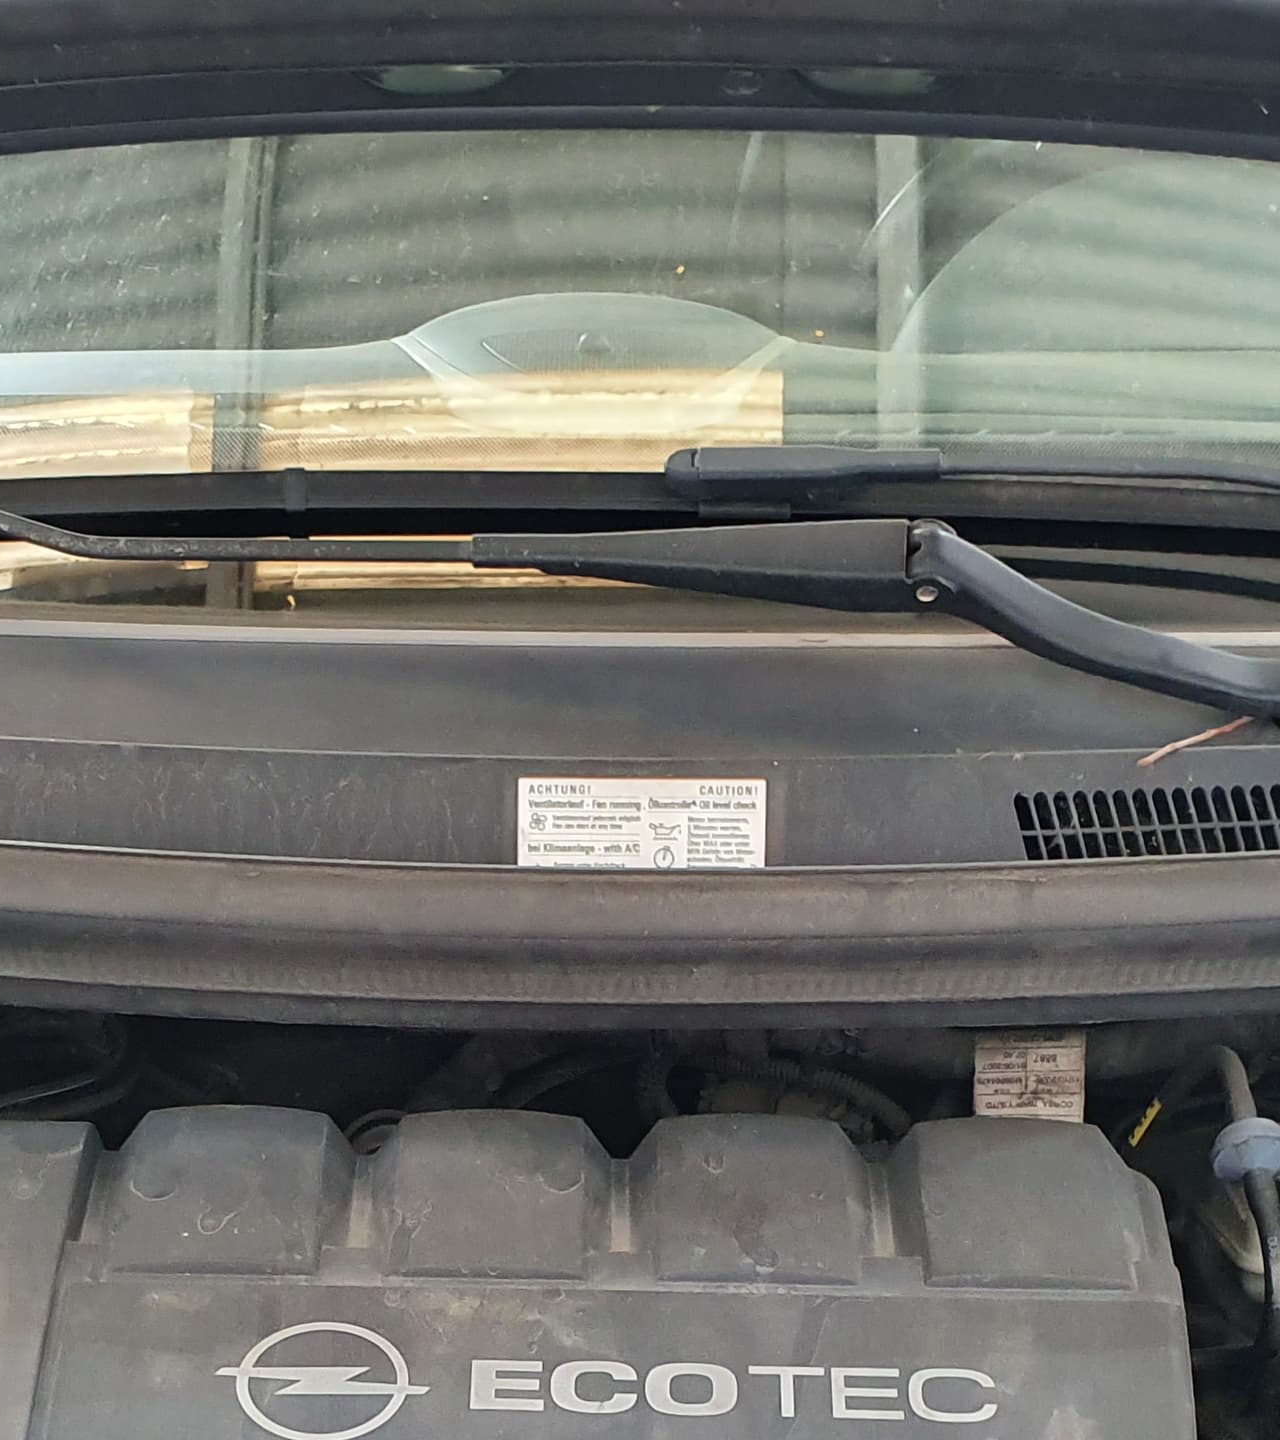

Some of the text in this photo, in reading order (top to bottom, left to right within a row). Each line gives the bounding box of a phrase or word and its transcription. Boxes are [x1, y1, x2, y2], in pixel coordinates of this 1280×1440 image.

[528, 784, 591, 795] ACHTUNG!
[699, 785, 758, 796] CAUTION!
[592, 799, 607, 809] Fan
[733, 800, 757, 810] check
[603, 843, 622, 853] with
[468, 1358, 1000, 1424] ECOTEC
